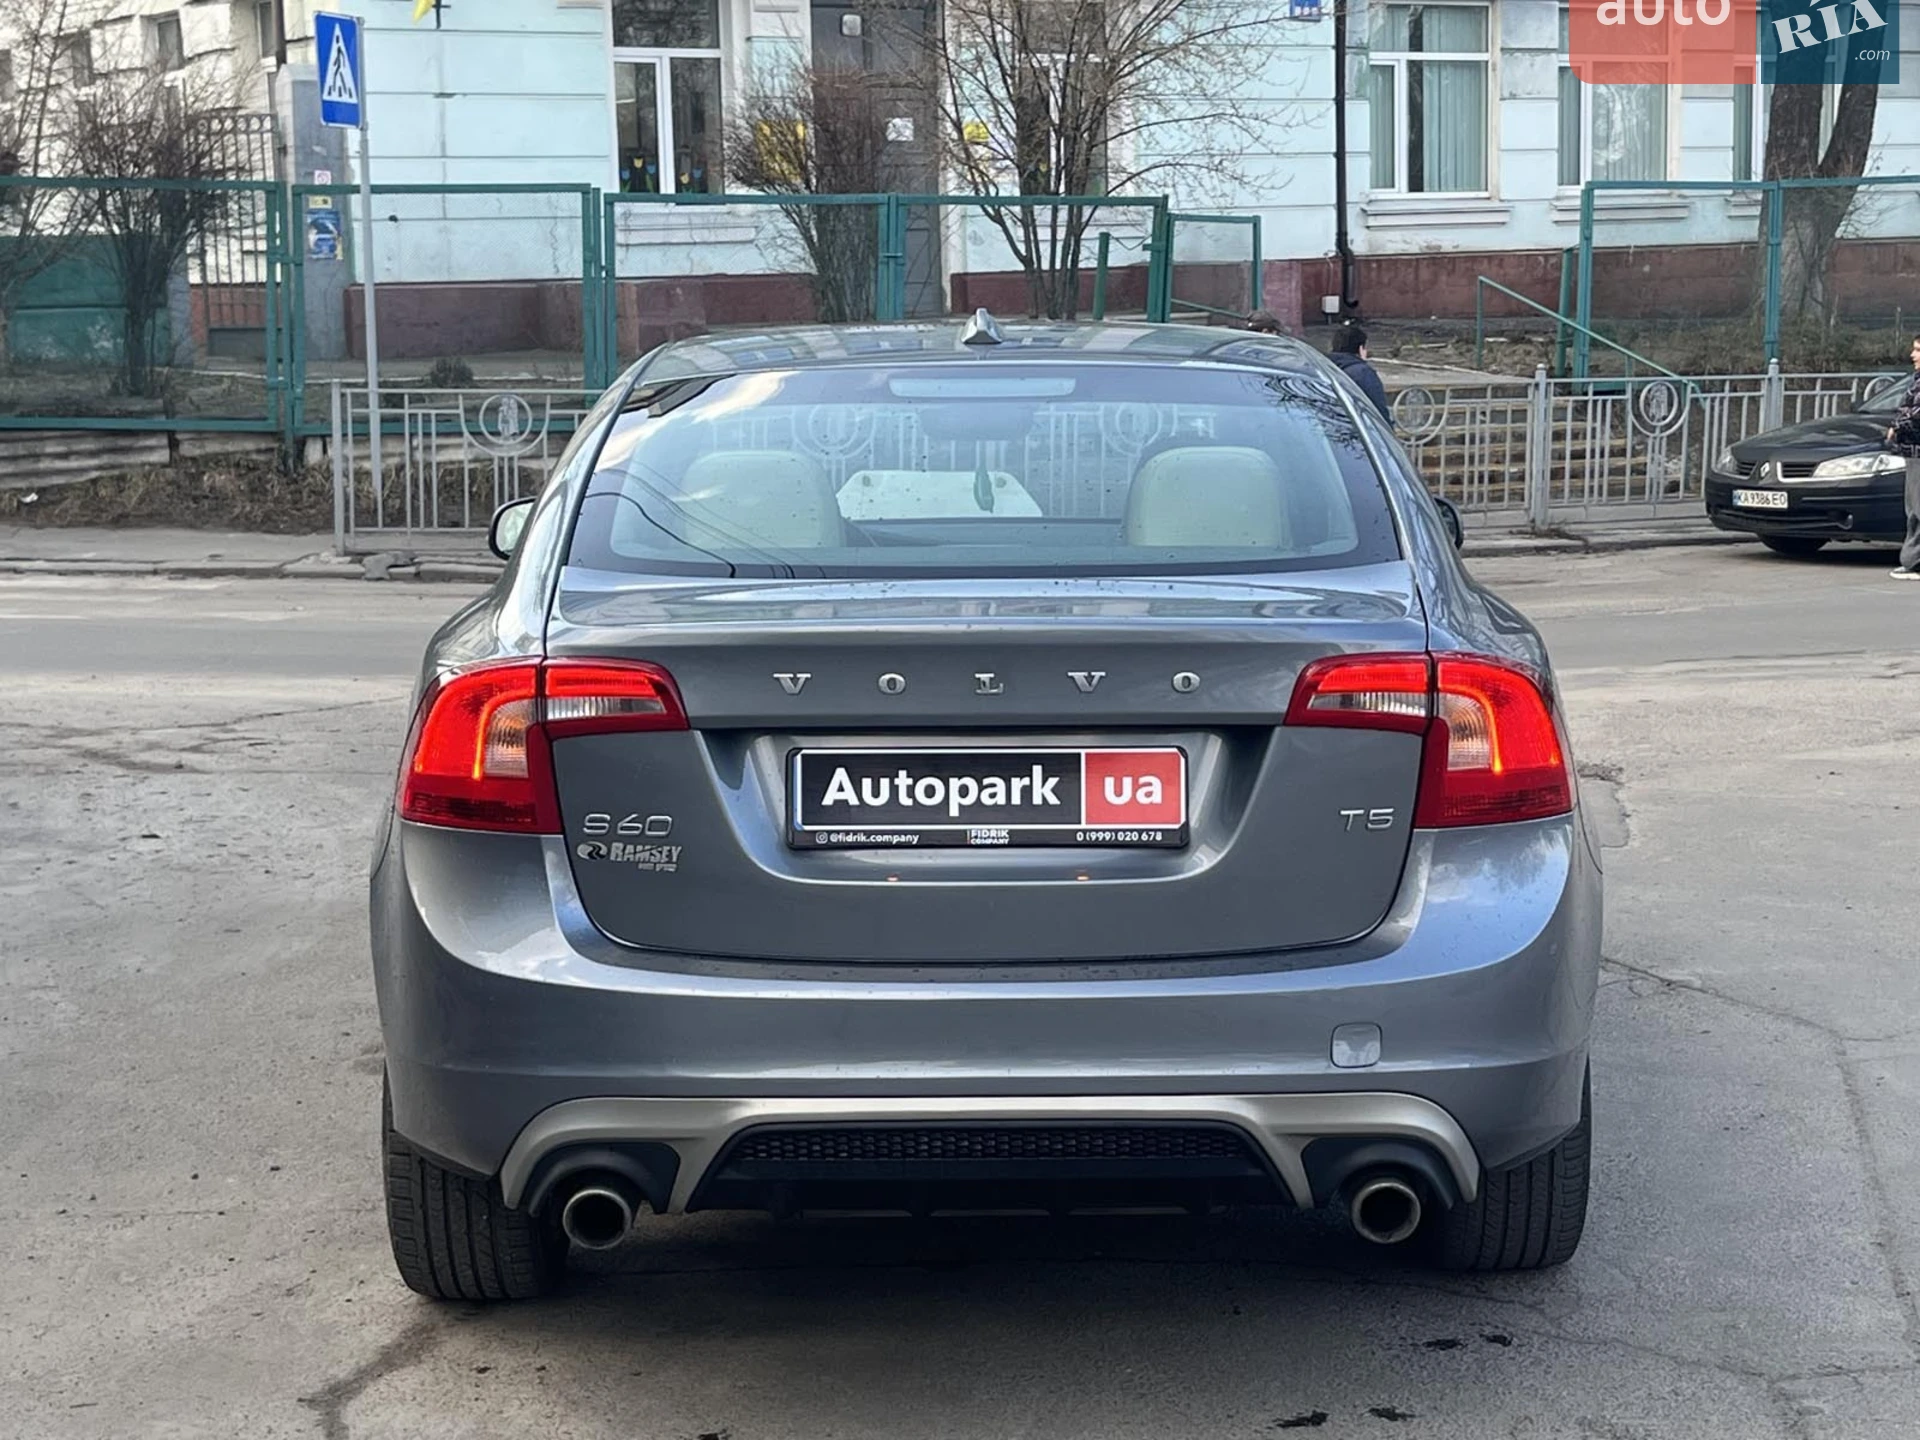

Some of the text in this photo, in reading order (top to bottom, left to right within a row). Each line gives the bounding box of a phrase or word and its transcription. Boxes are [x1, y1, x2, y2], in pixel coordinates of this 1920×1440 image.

[773, 671, 1201, 695] VOLVO
[821, 765, 1163, 817] Autopark ua
[583, 813, 672, 836] S60
[1340, 808, 1395, 831] T5
[829, 832, 919, 844] @fidrik.company
[970, 829, 1010, 838] FIDRIK
[1117, 831, 1139, 841] 020
[1141, 831, 1163, 841] 678
[610, 842, 682, 863] RAMSEY
